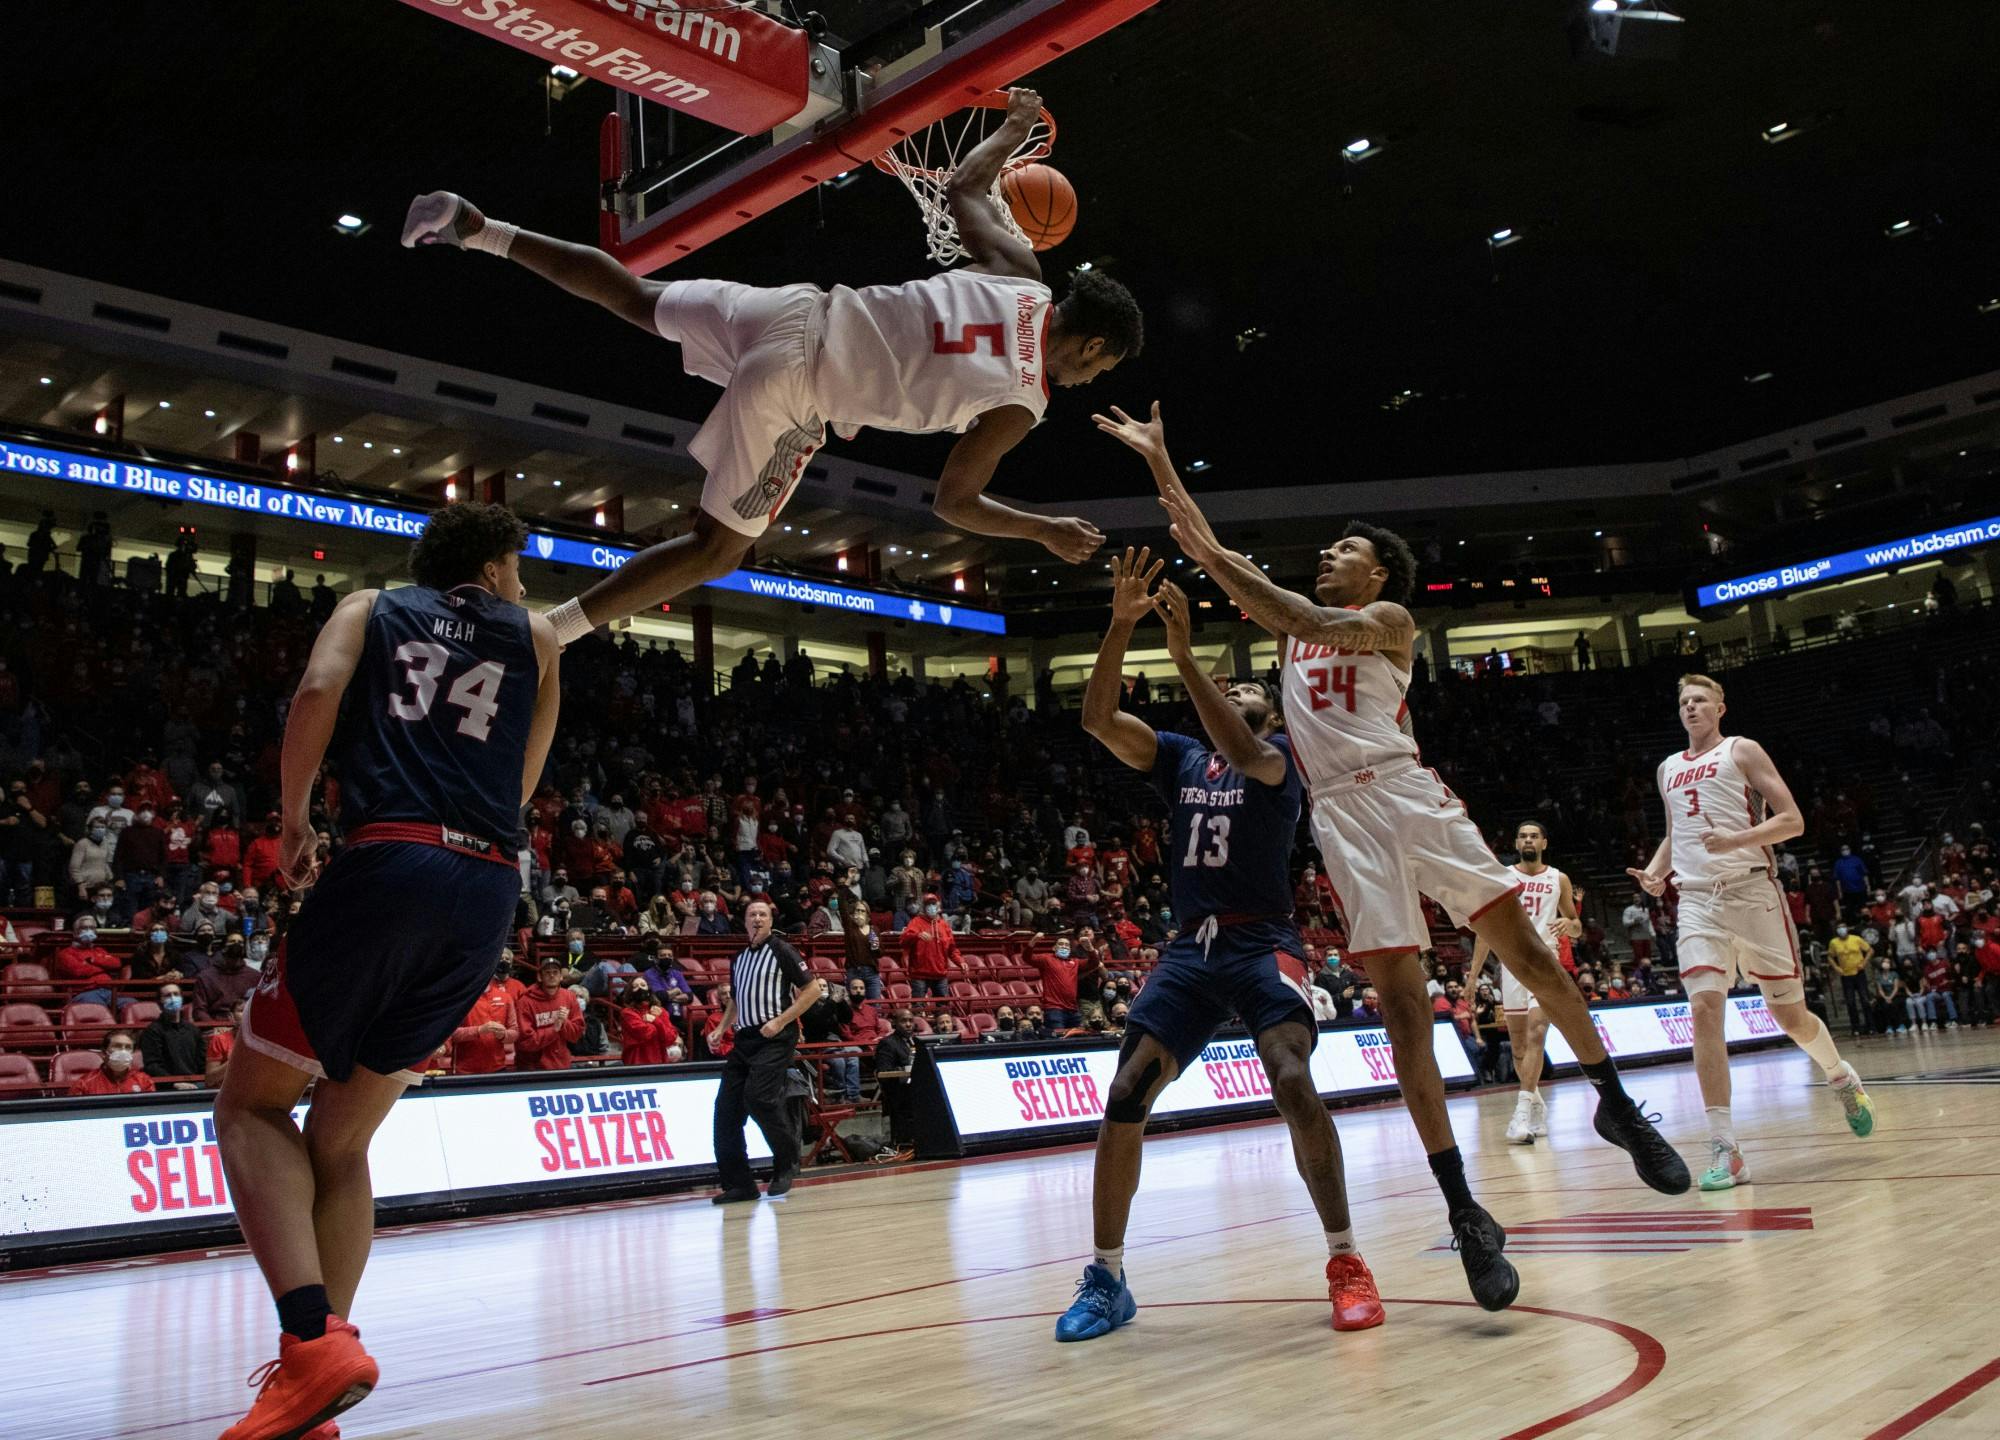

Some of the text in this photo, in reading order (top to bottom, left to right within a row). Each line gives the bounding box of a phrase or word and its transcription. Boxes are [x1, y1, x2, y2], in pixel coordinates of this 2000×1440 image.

[933, 320, 1006, 357] 5
[1016, 292, 1038, 364] MASHBURN
[68, 462, 117, 485] and
[123, 465, 182, 495] Blue
[187, 477, 261, 509] Shield
[267, 493, 293, 515] of
[295, 495, 345, 523] New
[1715, 576, 1778, 601] Choose
[1865, 523, 2000, 565] www.bcbsnm.c
[749, 577, 876, 612] www.bcbsnm.com
[433, 618, 476, 643] MEAH
[387, 641, 507, 743] 34
[1307, 665, 1357, 713] 24
[1666, 761, 1720, 793] LOBOS
[1208, 788, 1245, 807] STATE
[1684, 787, 1700, 818] 3
[1183, 812, 1231, 867] 13
[1200, 1043, 1258, 1062] BUD LIGH
[1354, 1033, 1379, 1047] BUD
[1004, 1057, 1088, 1079] BUD LIGHT
[1205, 1058, 1273, 1100] SELTZE
[528, 1088, 658, 1118] BUD LIGHT
[1012, 1074, 1105, 1122] SELTZER
[123, 1120, 199, 1148] BUD
[534, 1110, 675, 1173] SELTZER
